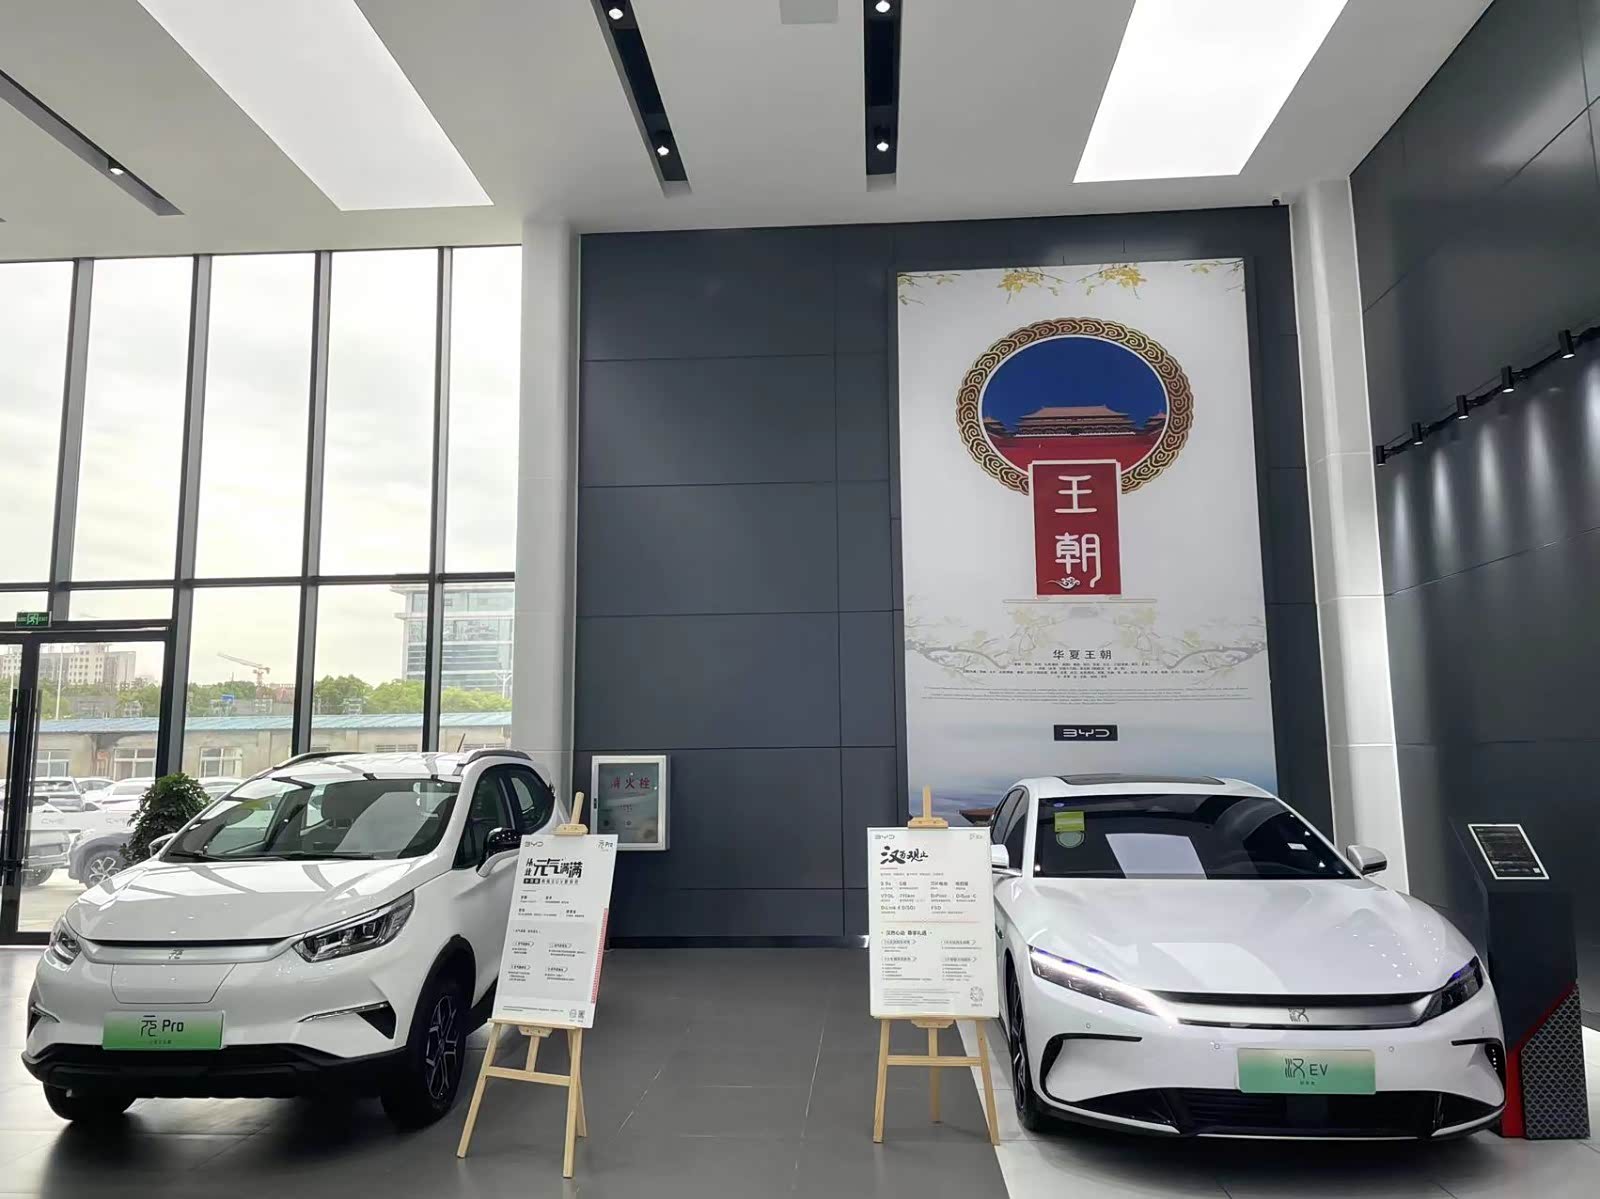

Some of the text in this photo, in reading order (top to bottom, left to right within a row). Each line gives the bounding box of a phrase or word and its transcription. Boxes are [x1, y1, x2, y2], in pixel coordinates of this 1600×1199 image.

[1054, 474, 1102, 588] 王朝
[1052, 649, 1113, 660] 华夏王朝
[1062, 728, 1110, 738] BYD
[610, 775, 651, 789] 消火栓
[162, 1019, 184, 1032] Pro
[1309, 1064, 1328, 1076] EV
